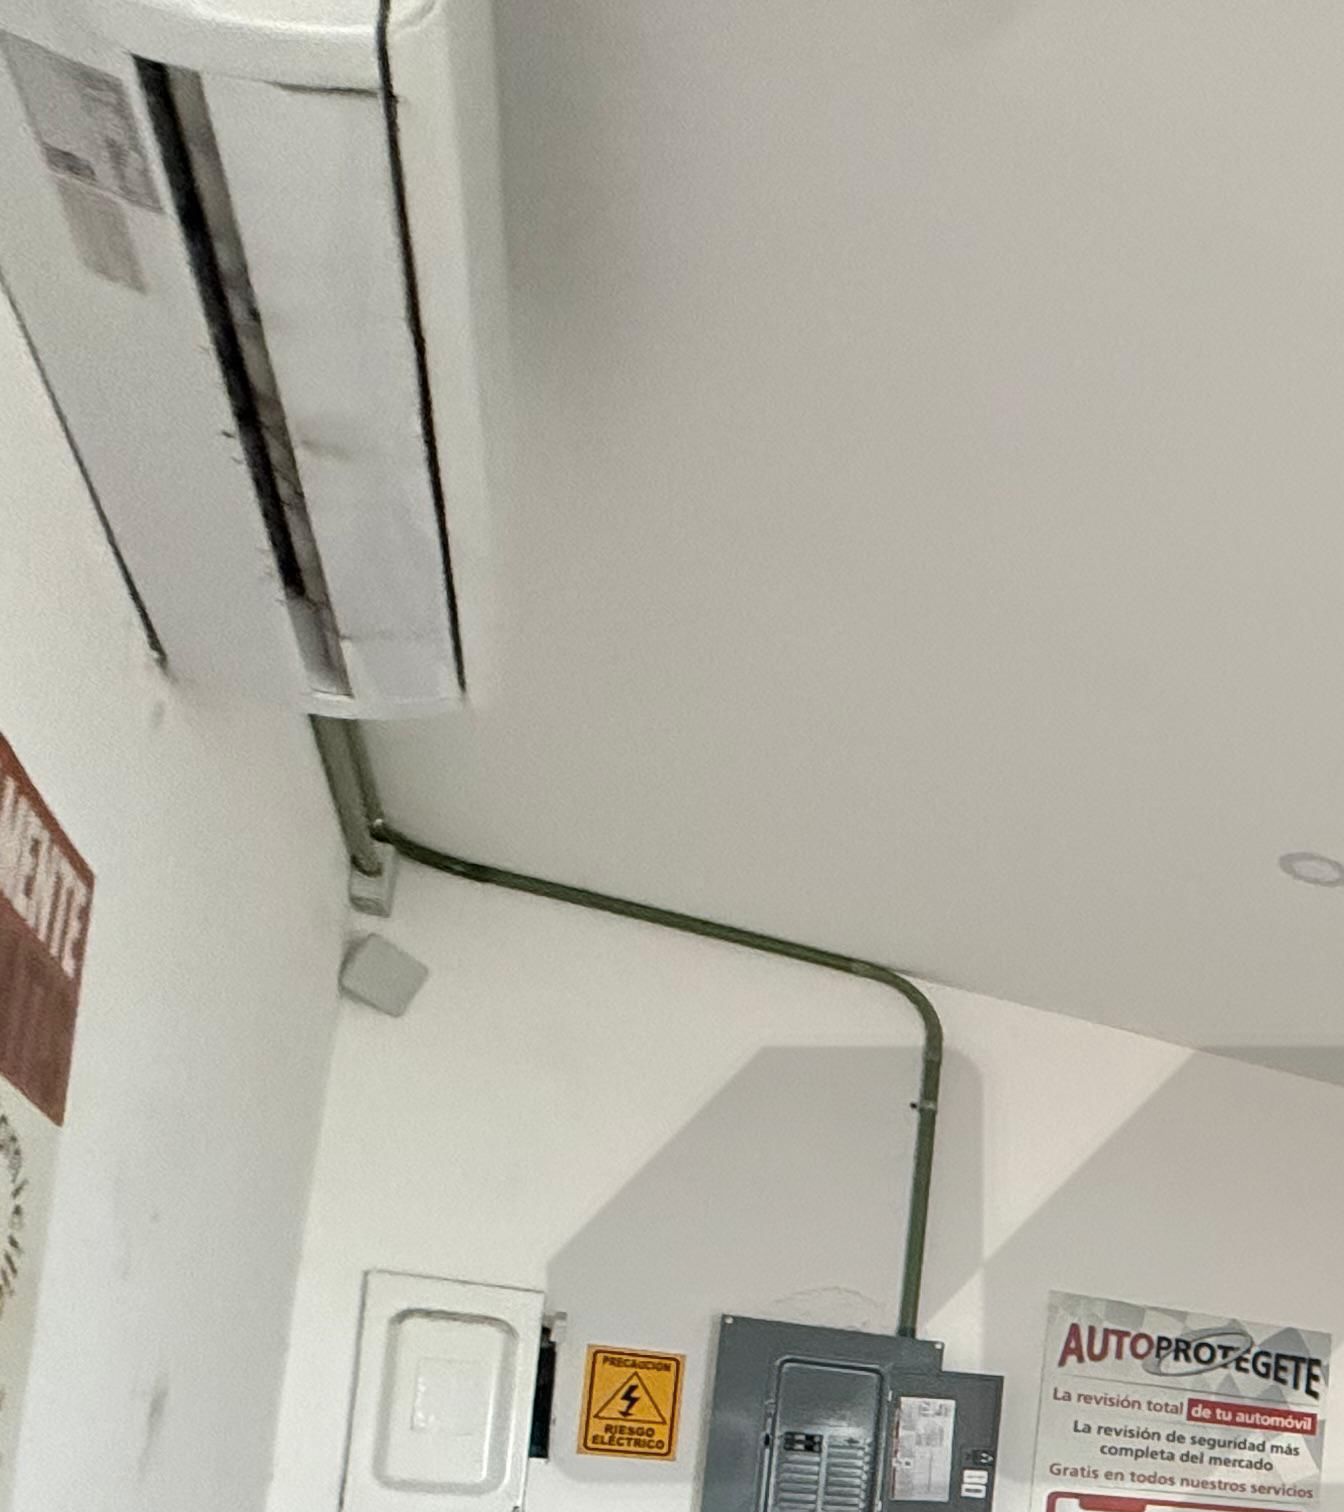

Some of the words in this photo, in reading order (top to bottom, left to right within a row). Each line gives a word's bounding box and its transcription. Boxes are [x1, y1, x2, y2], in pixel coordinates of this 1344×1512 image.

[1053, 1387, 1072, 1401] La
[1076, 1390, 1142, 1412] revisión
[1146, 1398, 1184, 1415] total
[1190, 1402, 1212, 1419] de
[1214, 1406, 1232, 1422] tu
[1235, 1409, 1313, 1432] automóvil
[604, 1423, 655, 1438] RIESGO
[1073, 1420, 1092, 1434] La
[1097, 1422, 1161, 1442] revisión
[1165, 1429, 1186, 1444] de
[1190, 1433, 1266, 1454] seguridad
[1270, 1441, 1300, 1457] más
[1099, 1444, 1175, 1464] completa
[1180, 1450, 1204, 1465] del
[1209, 1455, 1273, 1472] mercado
[1049, 1462, 1099, 1480] Gratis
[1104, 1470, 1125, 1481] en
[1130, 1470, 1175, 1486] todos
[1180, 1476, 1247, 1493] nuestros
[1250, 1483, 1314, 1499] servicios
